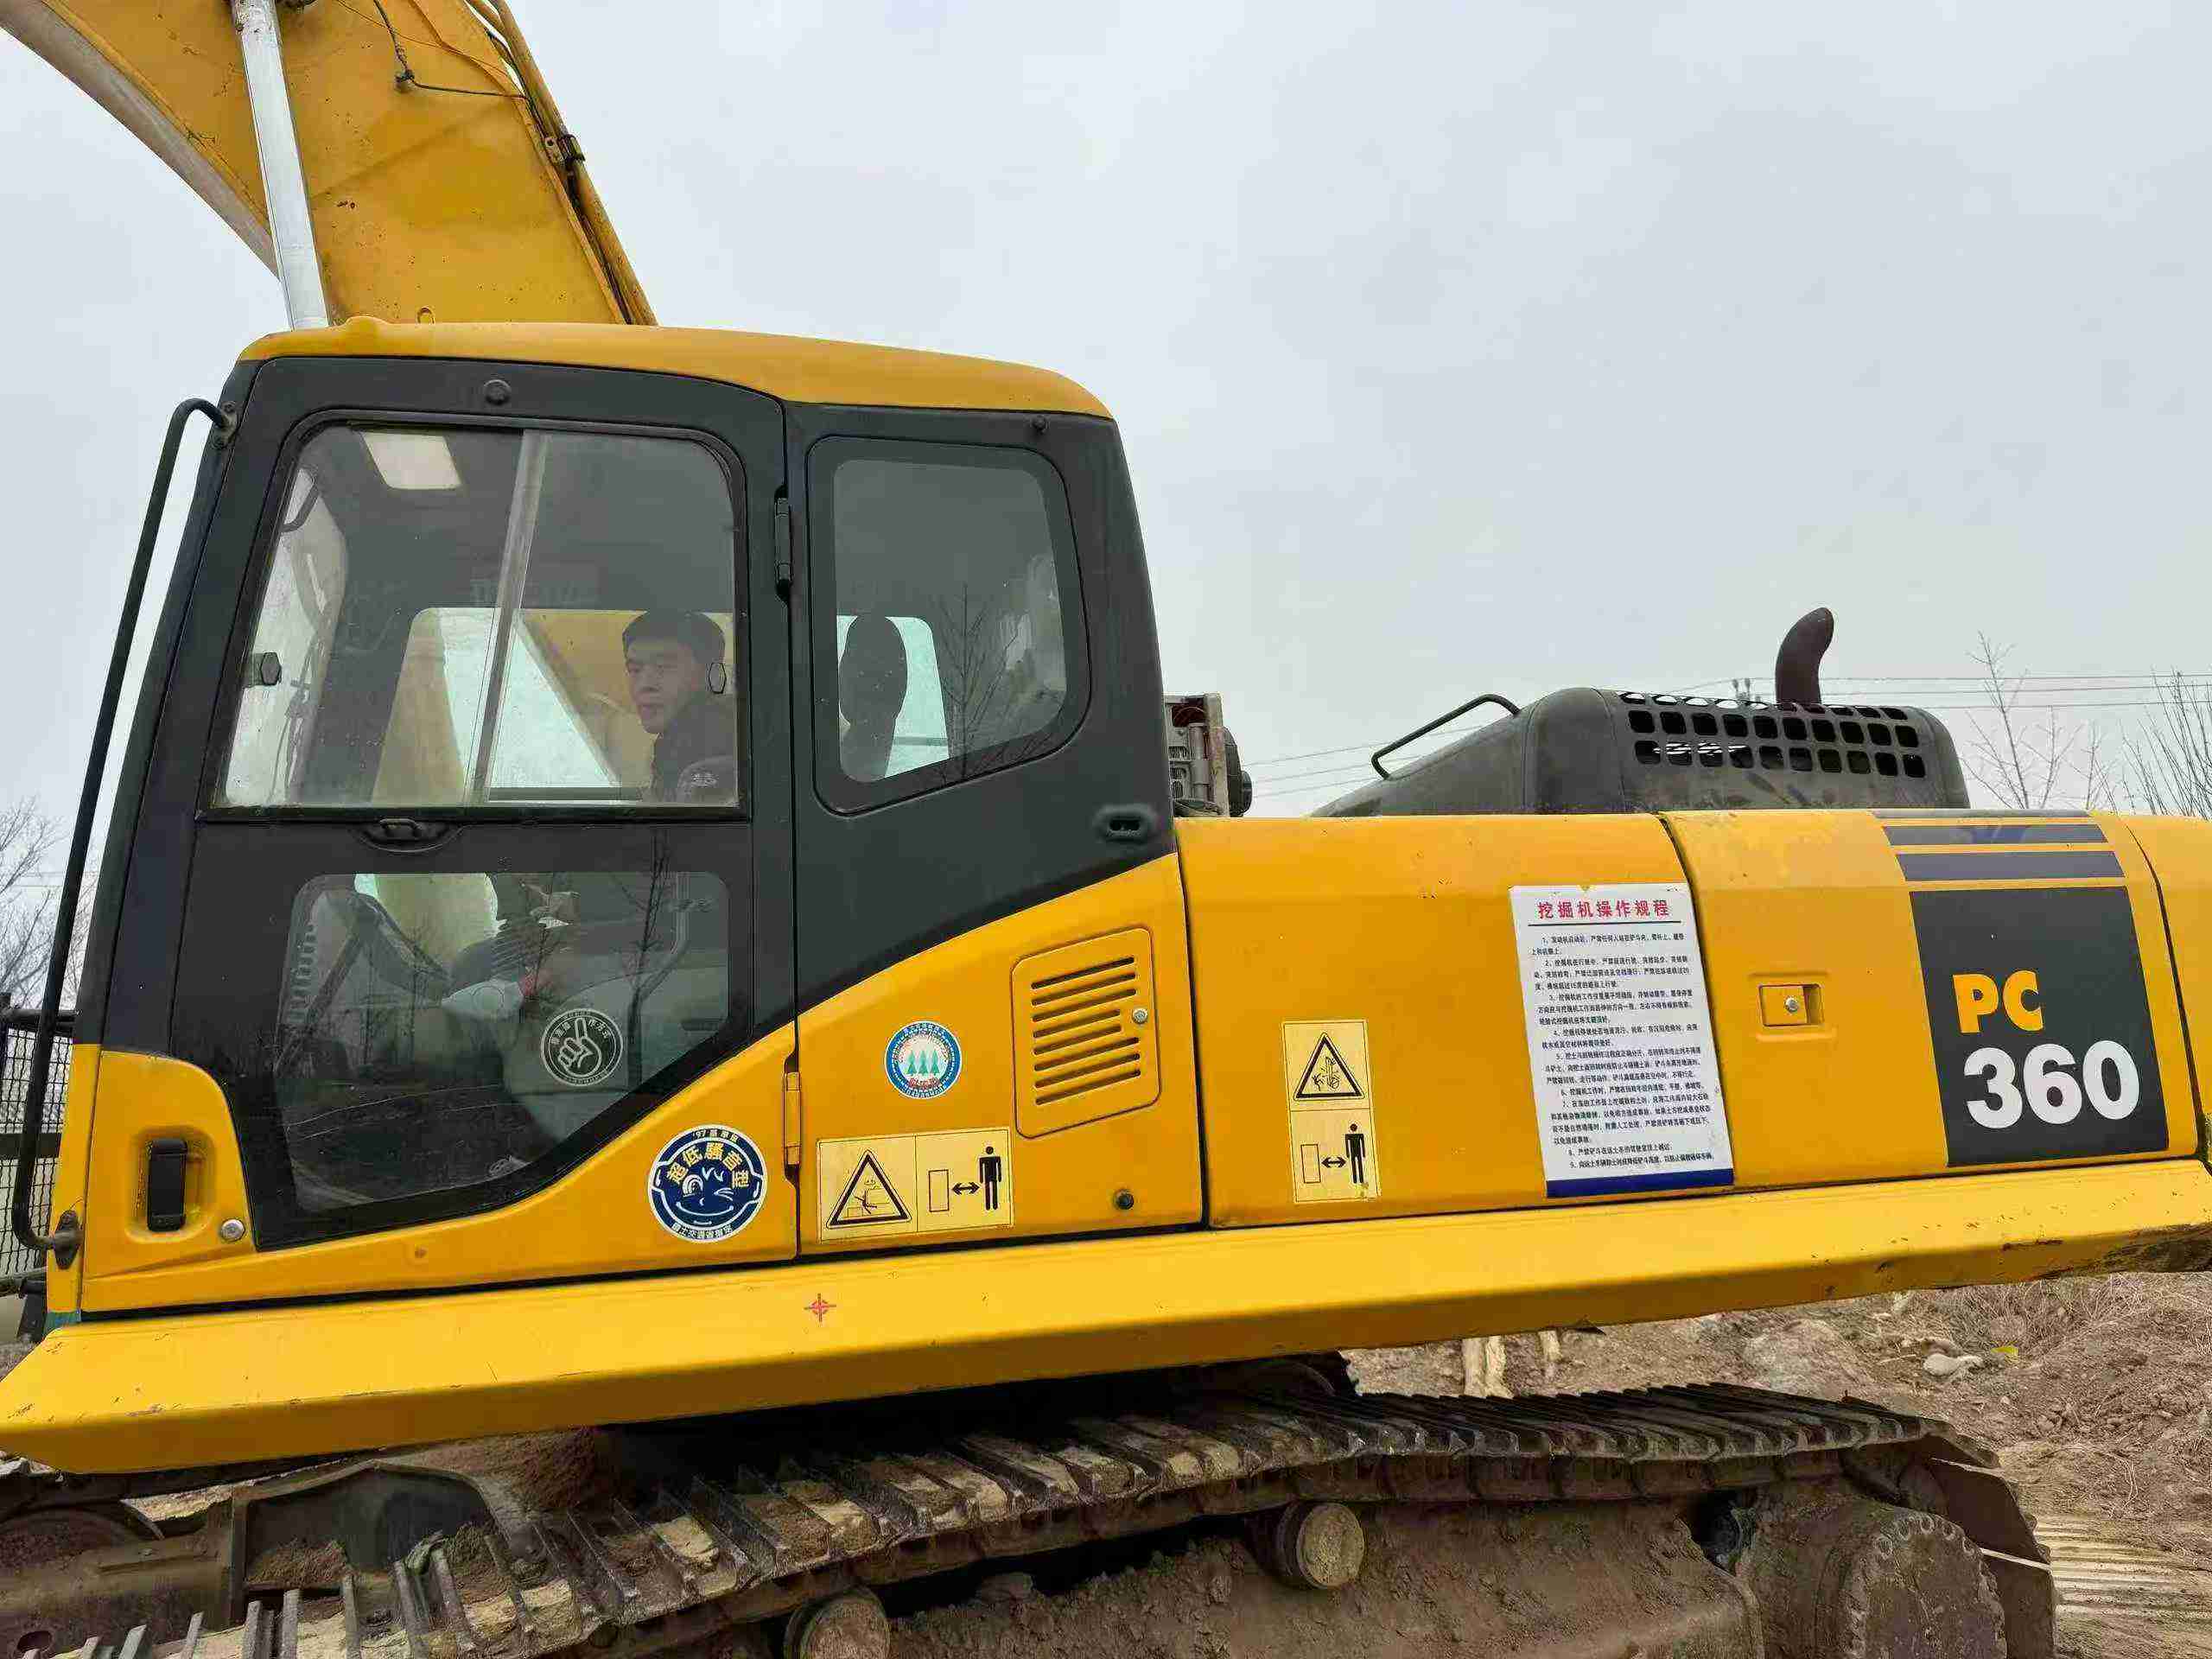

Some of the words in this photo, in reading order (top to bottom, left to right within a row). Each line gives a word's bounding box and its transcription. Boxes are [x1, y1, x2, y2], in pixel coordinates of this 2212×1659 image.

[1537, 899, 1669, 918] 挖掘机操作规程
[1952, 969, 2044, 1033] PC
[1963, 1039, 2140, 1129] 360
